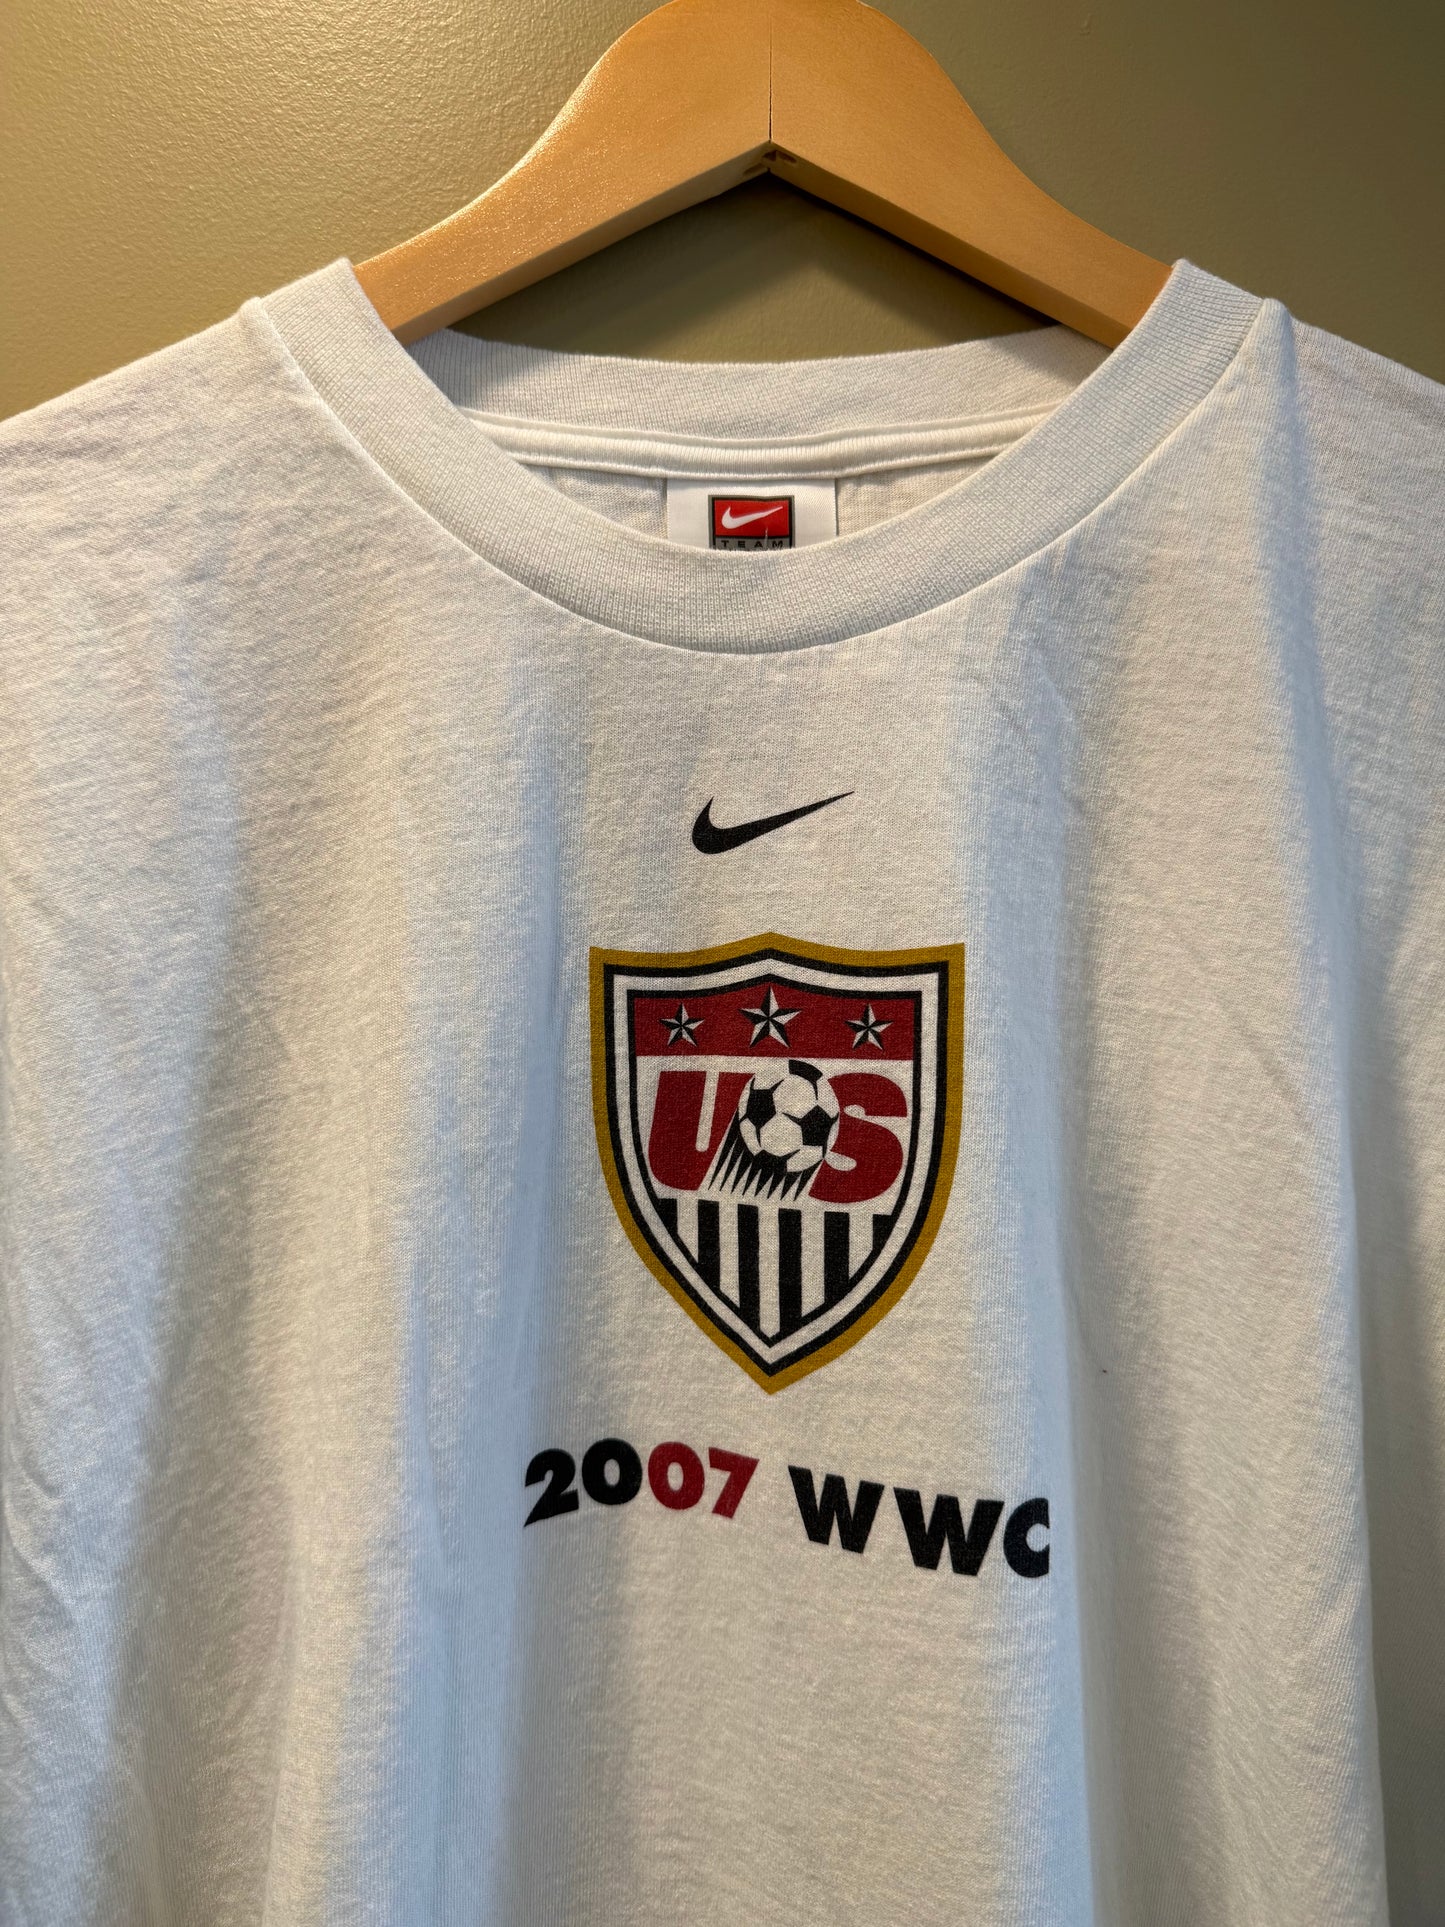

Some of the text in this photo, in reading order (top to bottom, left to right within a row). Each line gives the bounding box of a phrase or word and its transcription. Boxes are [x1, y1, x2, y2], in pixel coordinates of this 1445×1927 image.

[720, 540, 784, 549] TEAM
[648, 1070, 908, 1204] US
[523, 1437, 1051, 1578] 2007 WWC
